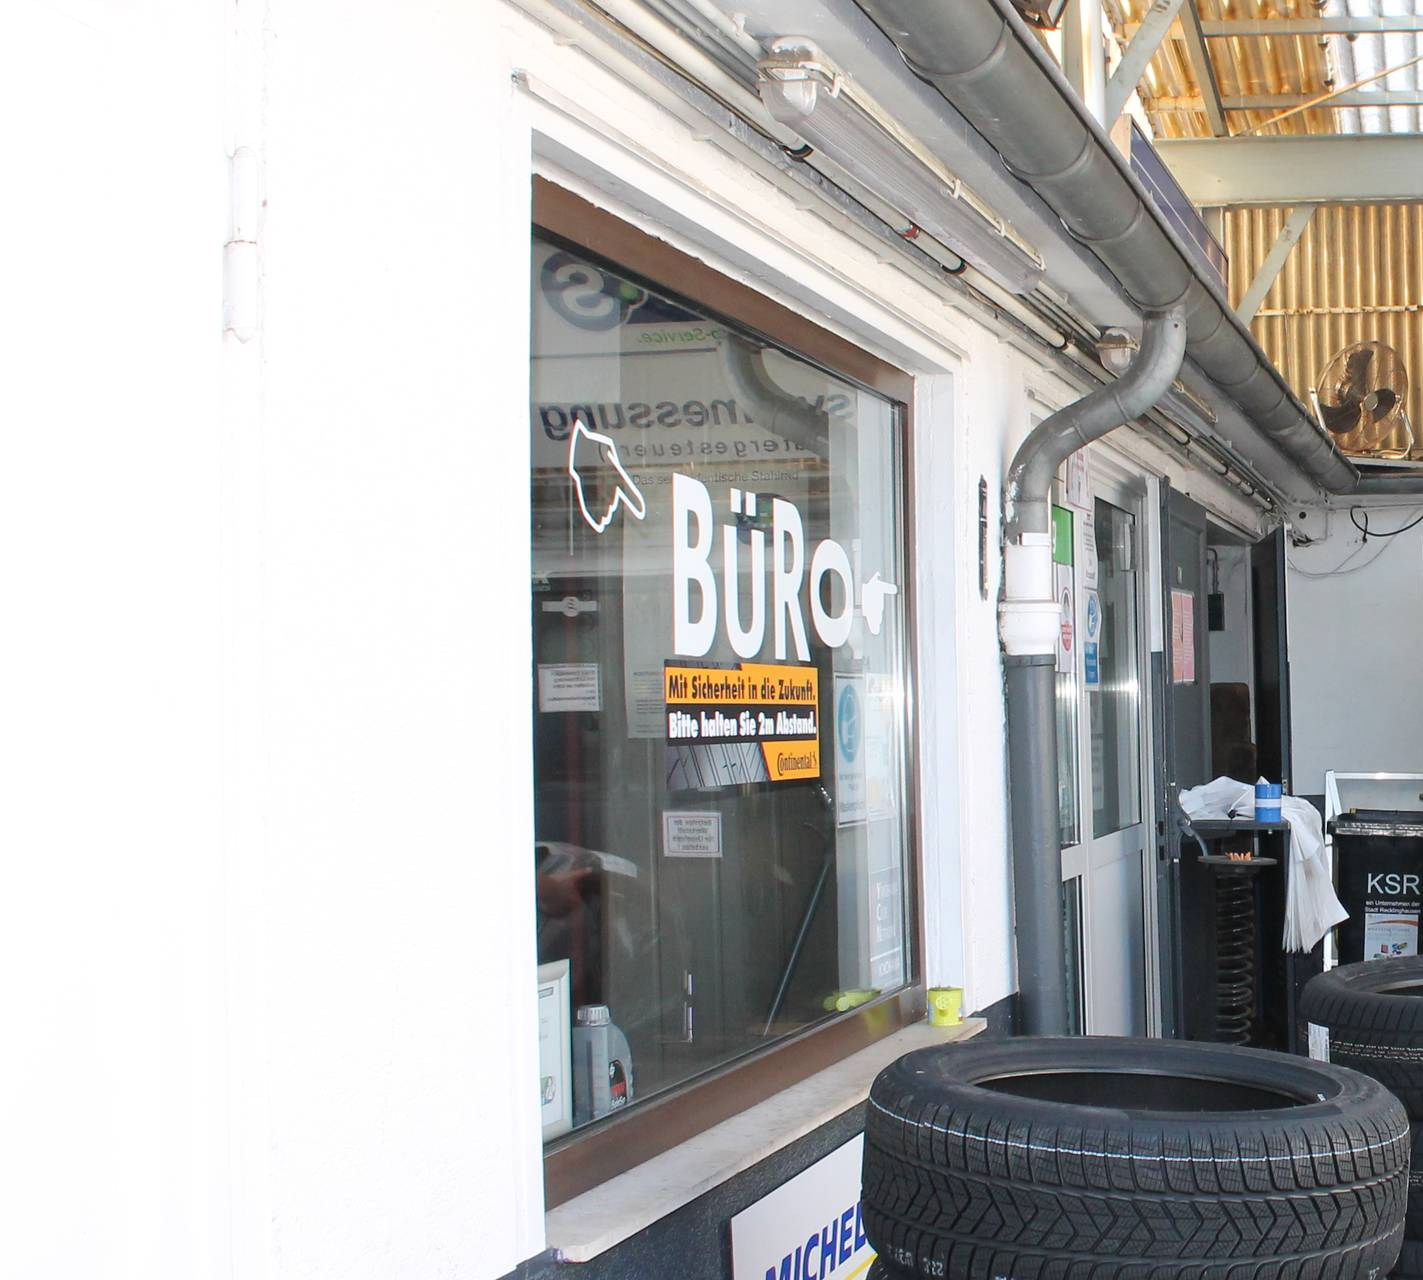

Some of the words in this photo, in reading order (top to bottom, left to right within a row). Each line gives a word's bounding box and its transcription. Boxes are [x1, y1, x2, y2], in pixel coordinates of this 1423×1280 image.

[668, 674, 688, 699] Mit
[691, 674, 745, 700] Sicherheit
[748, 676, 758, 700] in
[760, 676, 776, 700] die
[778, 679, 816, 701] Zukunft.
[668, 711, 699, 738] Bitte
[700, 710, 738, 737] halten
[739, 710, 757, 736] Sie
[757, 711, 775, 735] 2m
[775, 710, 817, 735] Abstand.
[777, 752, 812, 776] Continental
[1367, 873, 1421, 895] KSR
